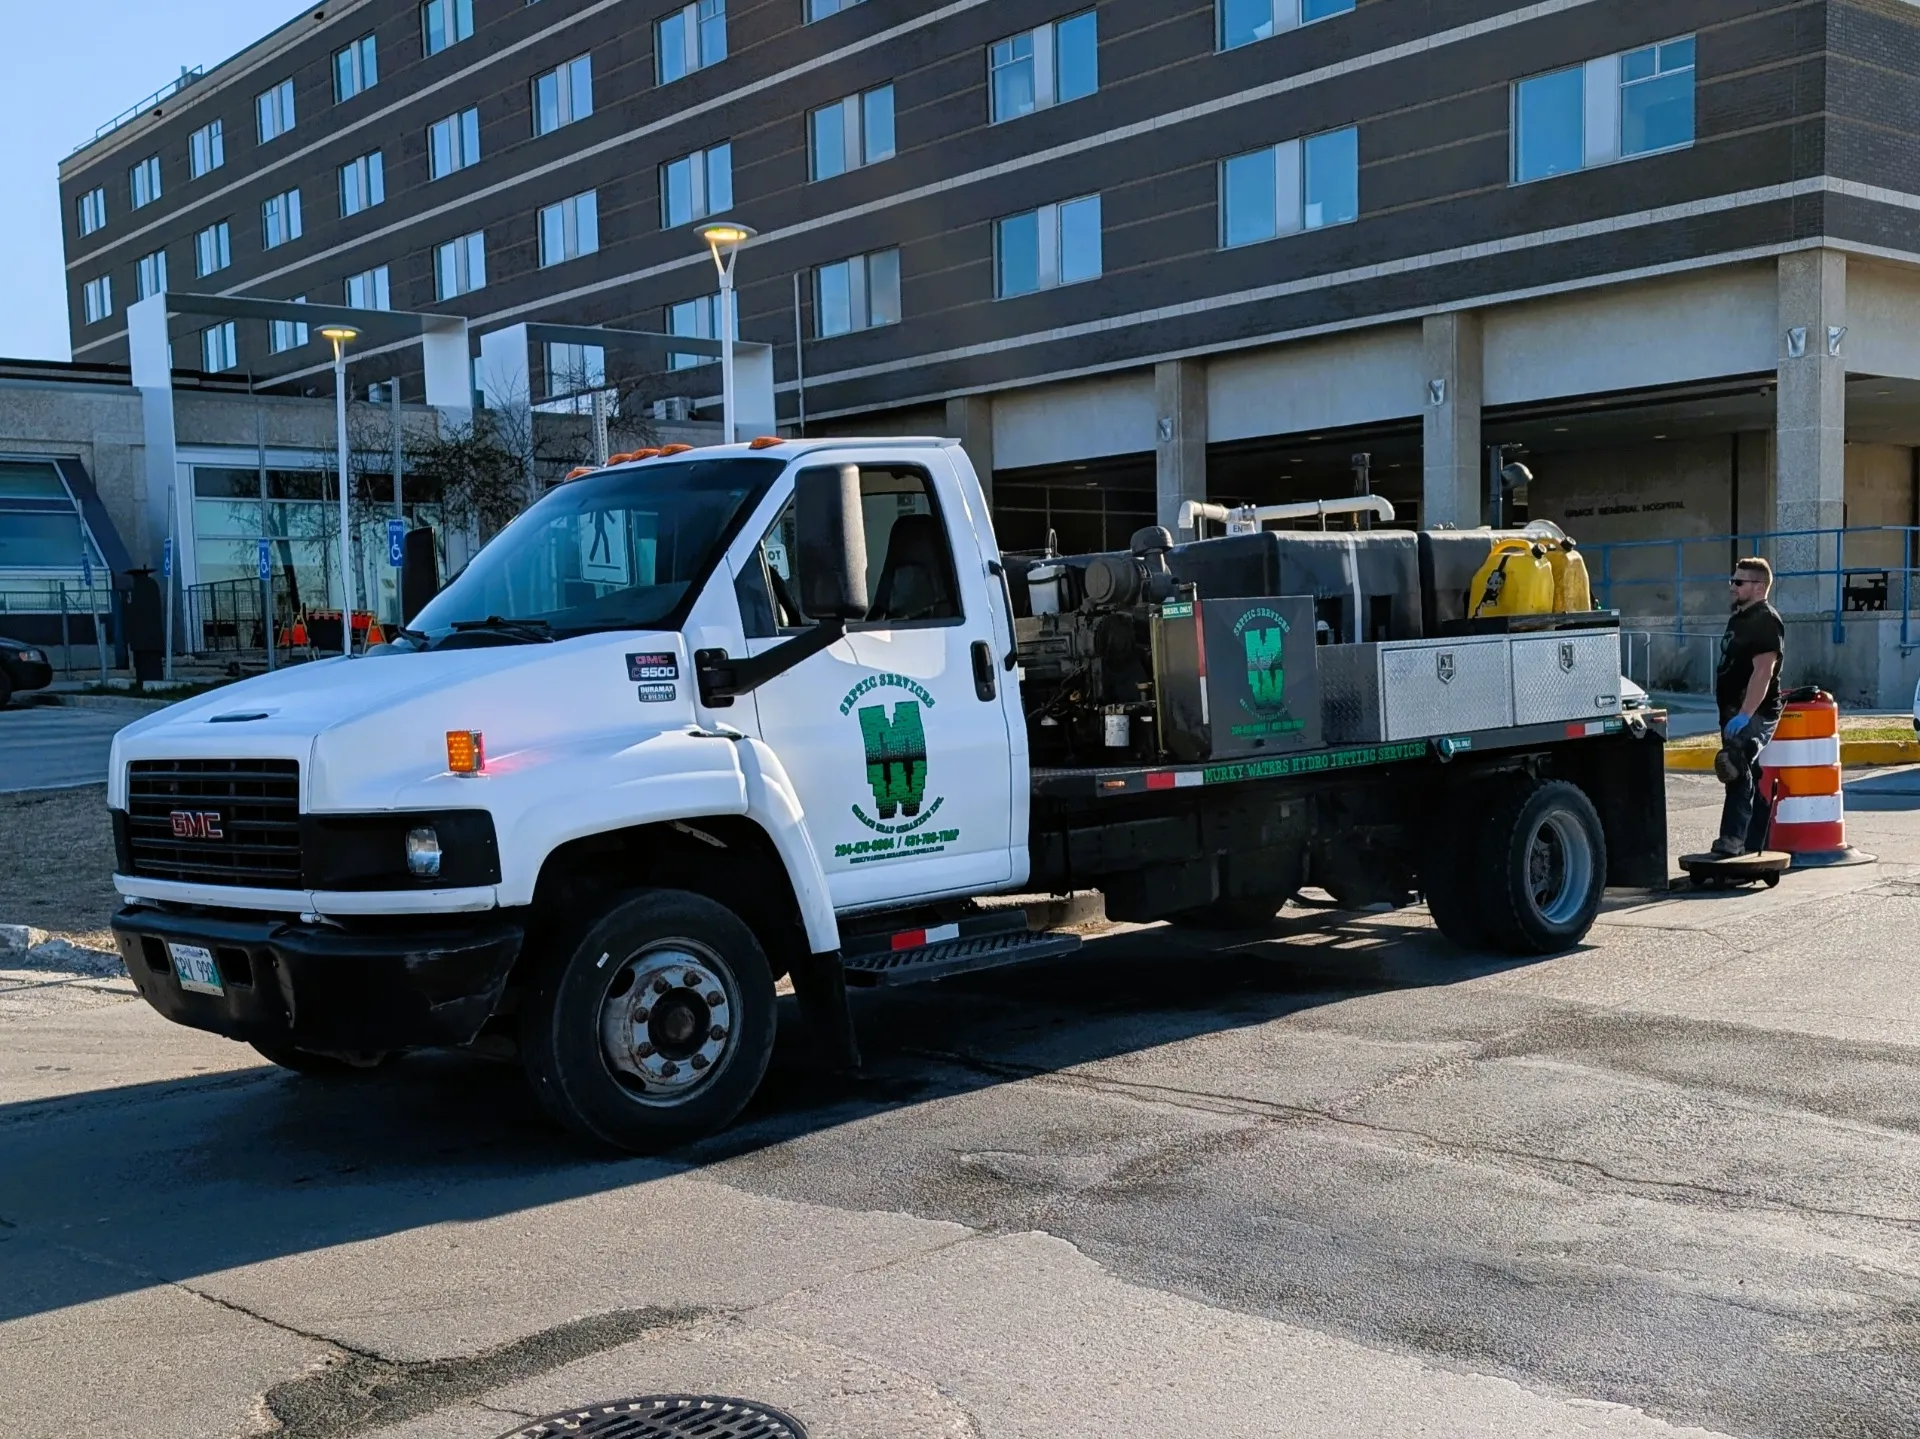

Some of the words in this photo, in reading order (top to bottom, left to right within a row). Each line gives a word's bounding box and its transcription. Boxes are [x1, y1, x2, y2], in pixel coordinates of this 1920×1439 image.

[1642, 501, 1685, 512] HOSPITAL
[767, 550, 781, 561] OT
[1233, 609, 1256, 637] SEPTIC
[1256, 607, 1291, 633] SERVICES
[635, 655, 669, 664] GMC
[632, 666, 675, 678] C5500
[640, 685, 674, 693] DURAMAX
[839, 675, 878, 716] SEPTIC
[879, 673, 936, 708] SERVICES
[1204, 765, 1245, 782] MURKY
[1247, 759, 1289, 777] WATERS
[1292, 755, 1328, 772] HYDRO
[1330, 749, 1376, 767] JETTING
[1378, 743, 1427, 760] SERVICES
[170, 811, 223, 838] GMC
[174, 956, 195, 981] CPV
[196, 959, 217, 983] 999
